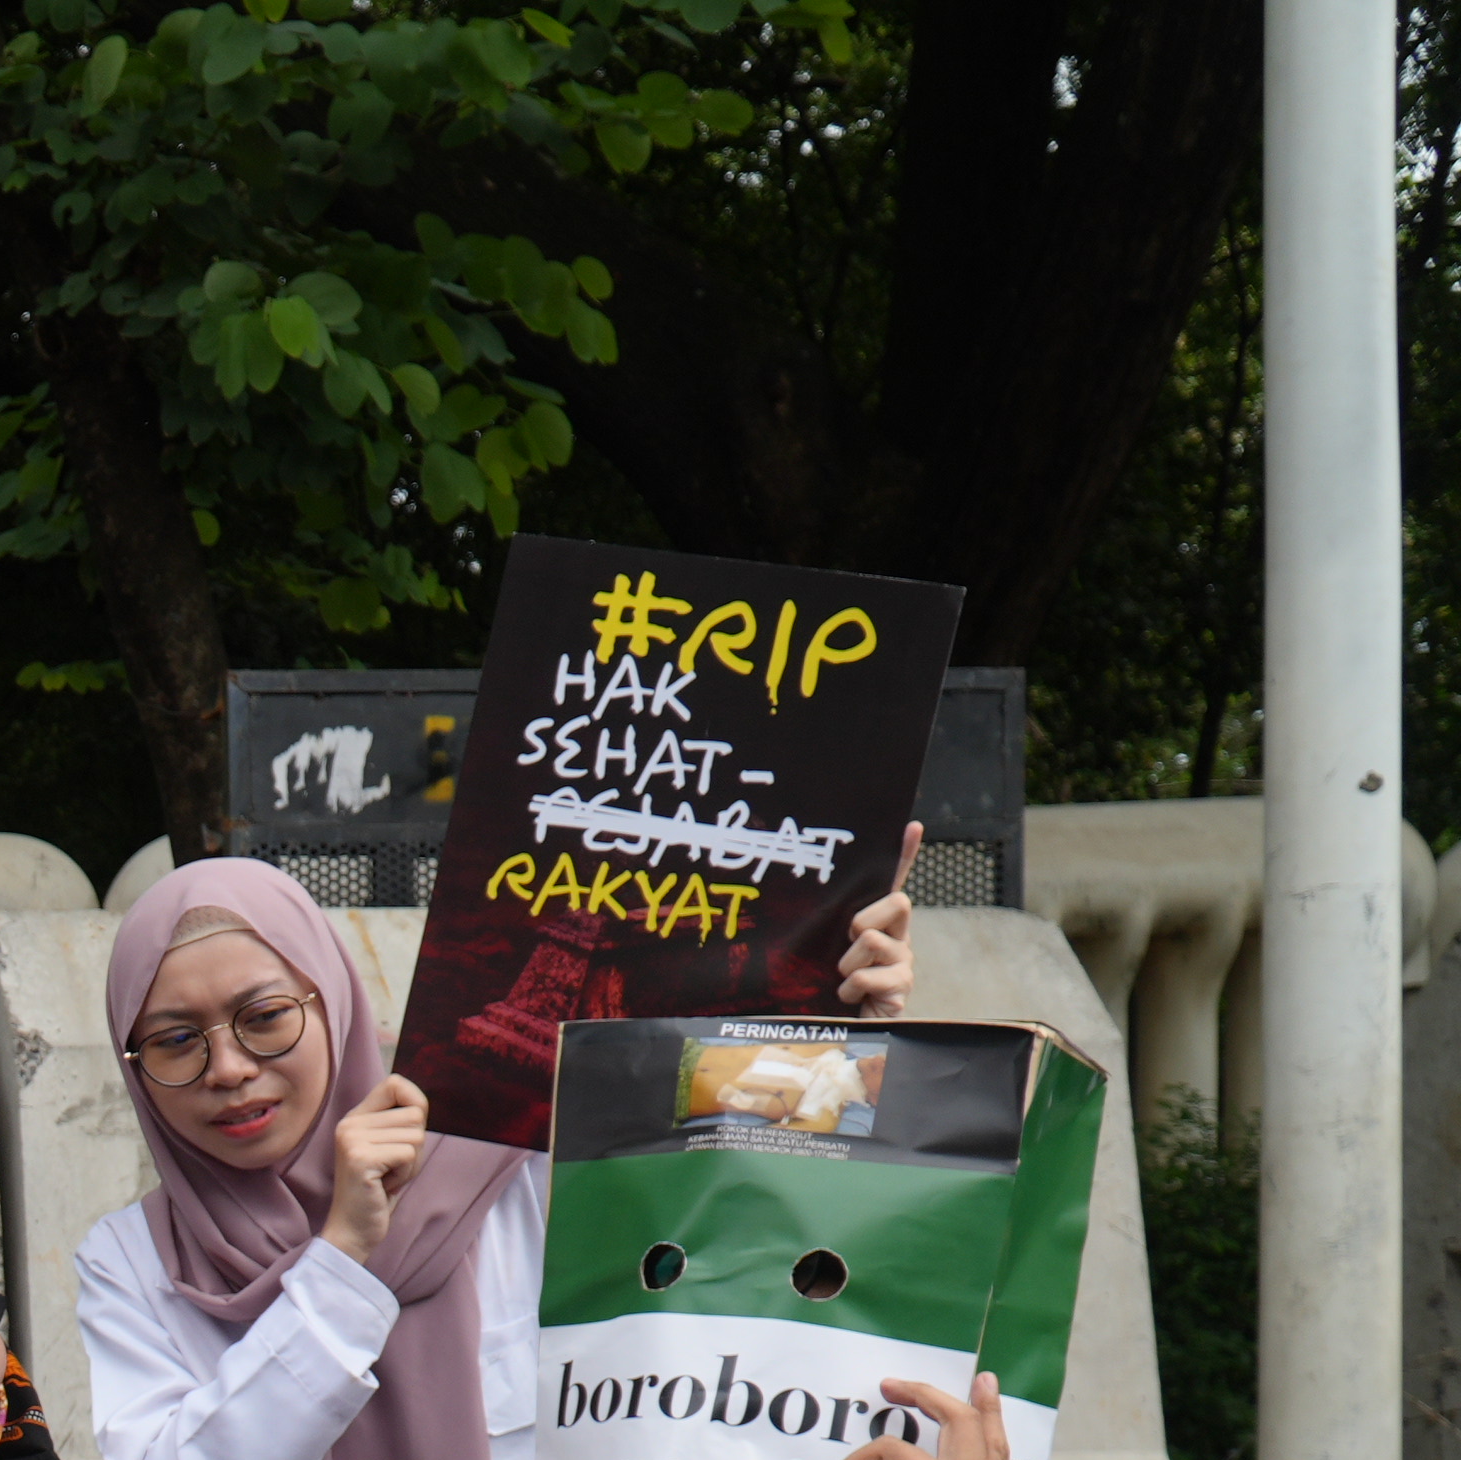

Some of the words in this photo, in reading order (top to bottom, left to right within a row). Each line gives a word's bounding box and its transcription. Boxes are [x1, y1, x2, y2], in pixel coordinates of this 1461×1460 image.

[592, 570, 877, 712] #RIP
[554, 650, 696, 722] HAK
[517, 714, 733, 796] SEHAT
[487, 852, 760, 947] RAKYAT
[720, 1021, 849, 1043] PERINGATAN
[717, 1124, 750, 1135] ROKOK
[750, 1134, 775, 1145] SAYA
[777, 1137, 803, 1148] SATU
[805, 1139, 851, 1152] PERSATU
[557, 1353, 922, 1446] boroboro
